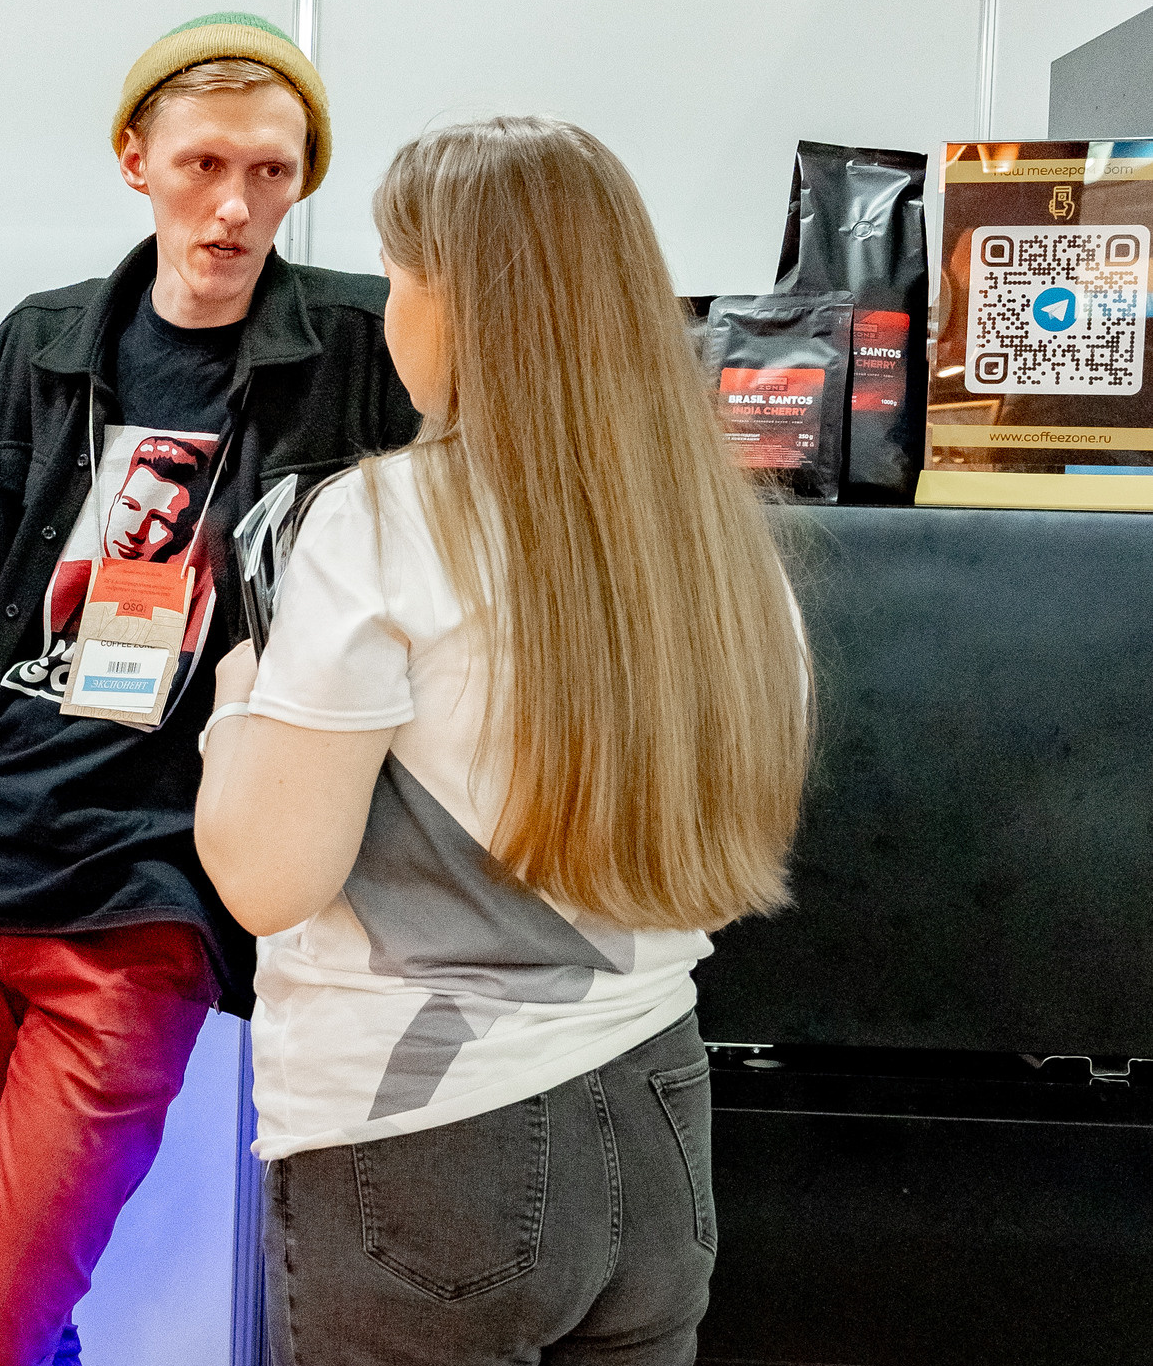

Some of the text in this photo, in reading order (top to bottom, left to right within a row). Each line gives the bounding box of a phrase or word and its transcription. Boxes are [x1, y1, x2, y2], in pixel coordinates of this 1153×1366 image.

[859, 347, 902, 359] SANTOS
[856, 360, 896, 370] CHERRY
[728, 394, 813, 405] BRASIL SANTOS
[732, 406, 807, 416] INDIA CHERRY
[989, 431, 1112, 444] www.coffeezone.ru
[90, 679, 149, 691] ЭКСПОНЕНТ
